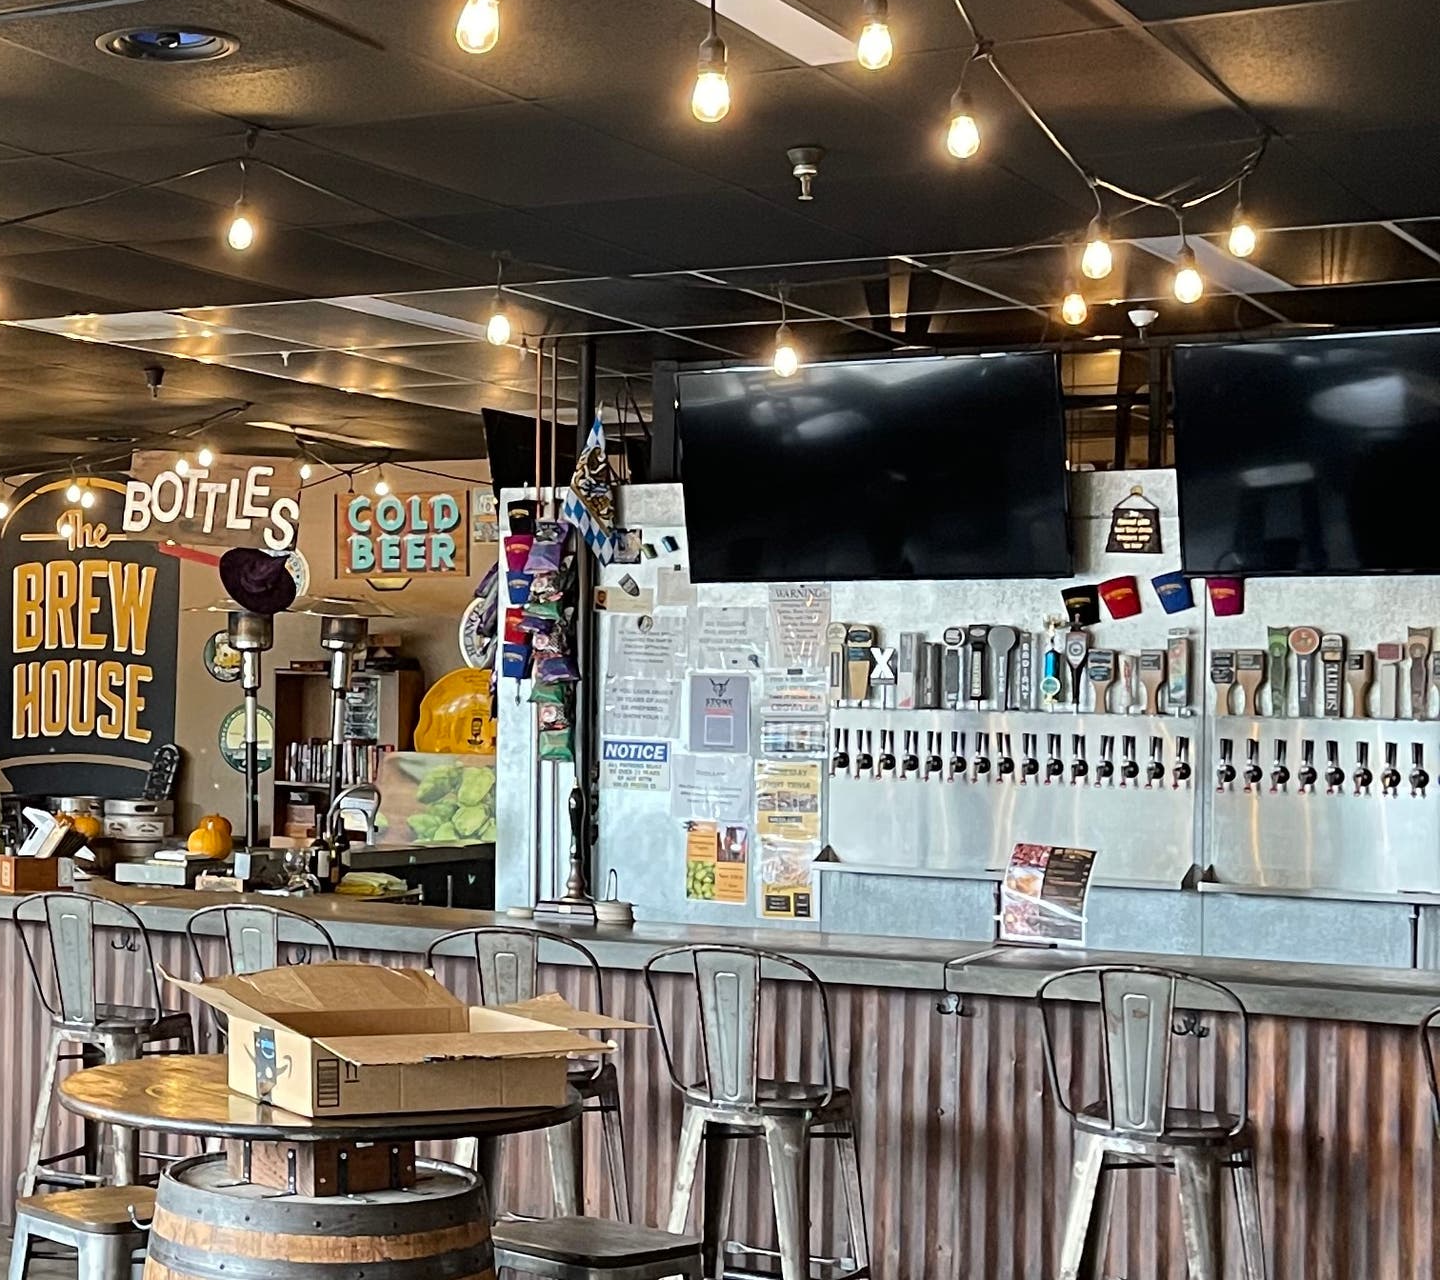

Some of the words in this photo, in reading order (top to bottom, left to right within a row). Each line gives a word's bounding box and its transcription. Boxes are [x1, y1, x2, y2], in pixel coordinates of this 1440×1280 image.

[57, 509, 111, 552] The
[122, 466, 300, 551] BOTTLES
[347, 494, 462, 534] COLD
[347, 533, 458, 573] BEER
[12, 560, 158, 655] BREW
[1021, 642, 1031, 700] RADIANT
[11, 659, 154, 745] HOUSE
[604, 743, 666, 760] NOTICE
